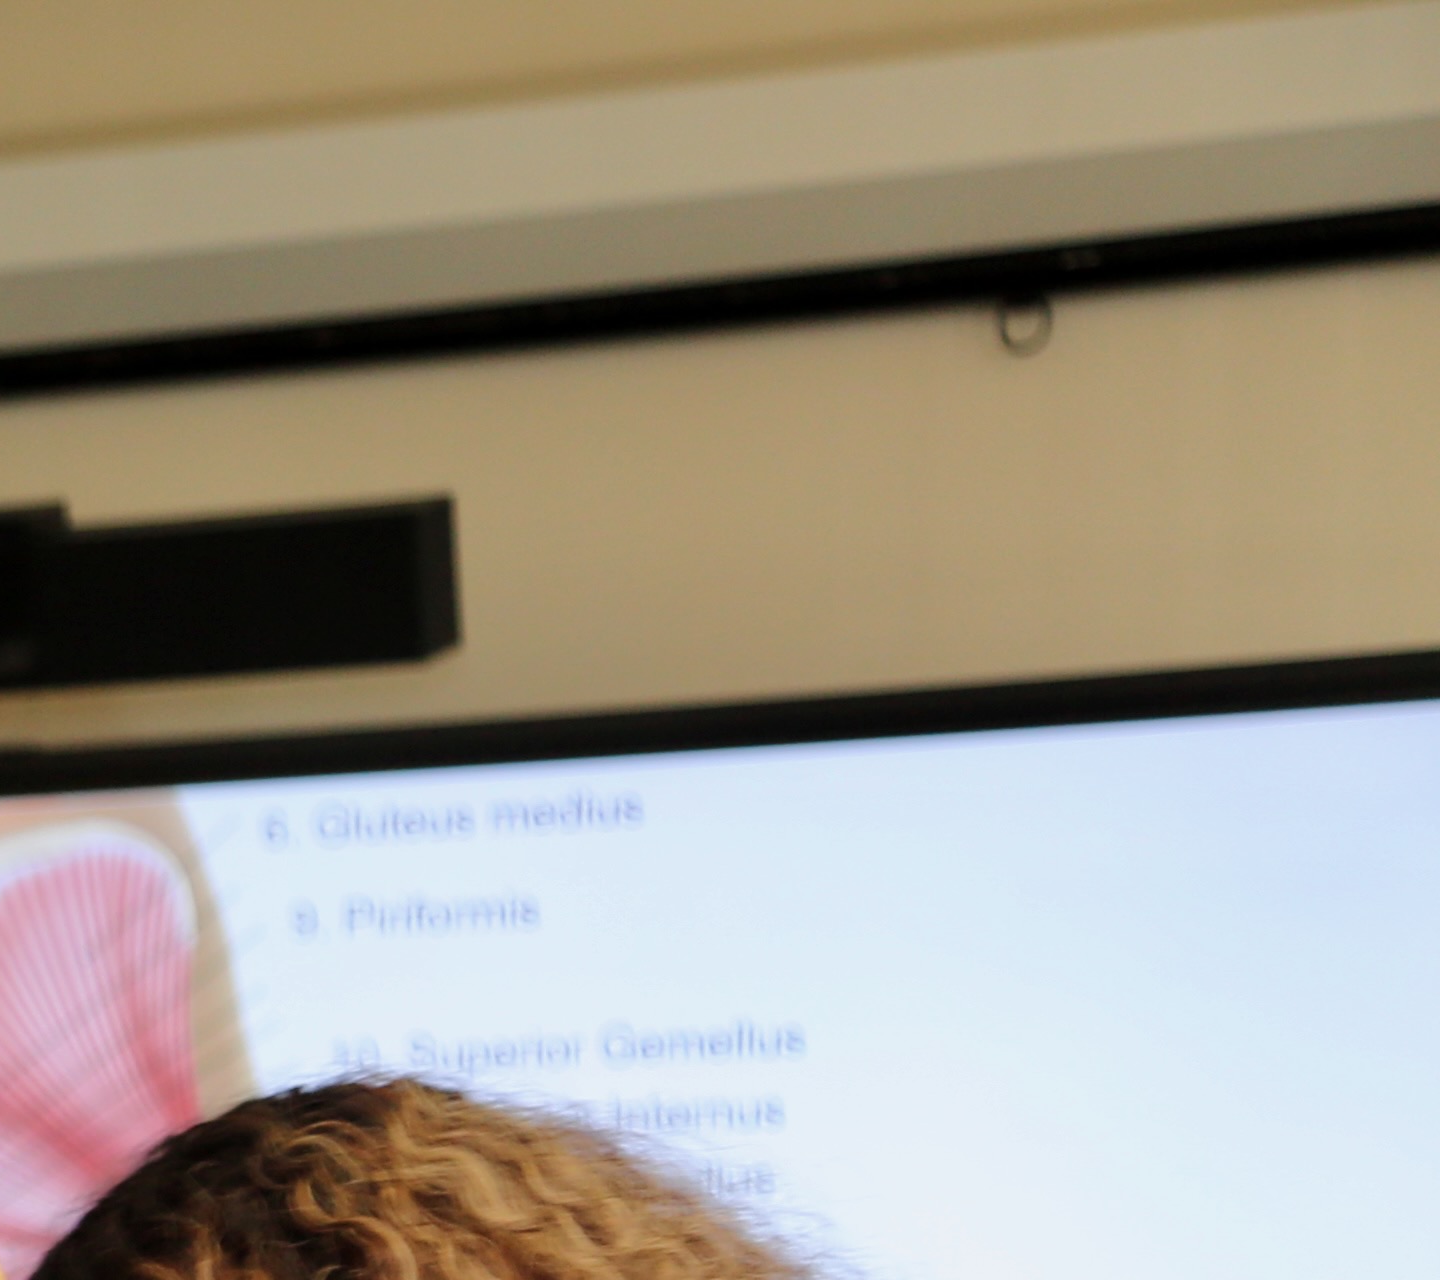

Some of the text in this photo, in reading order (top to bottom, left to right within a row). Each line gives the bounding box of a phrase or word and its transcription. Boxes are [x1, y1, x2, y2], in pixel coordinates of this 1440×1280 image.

[491, 789, 644, 832] medius
[343, 893, 539, 938] Piriformis
[409, 1030, 581, 1073] Superior
[598, 1021, 806, 1066] Gemellus
